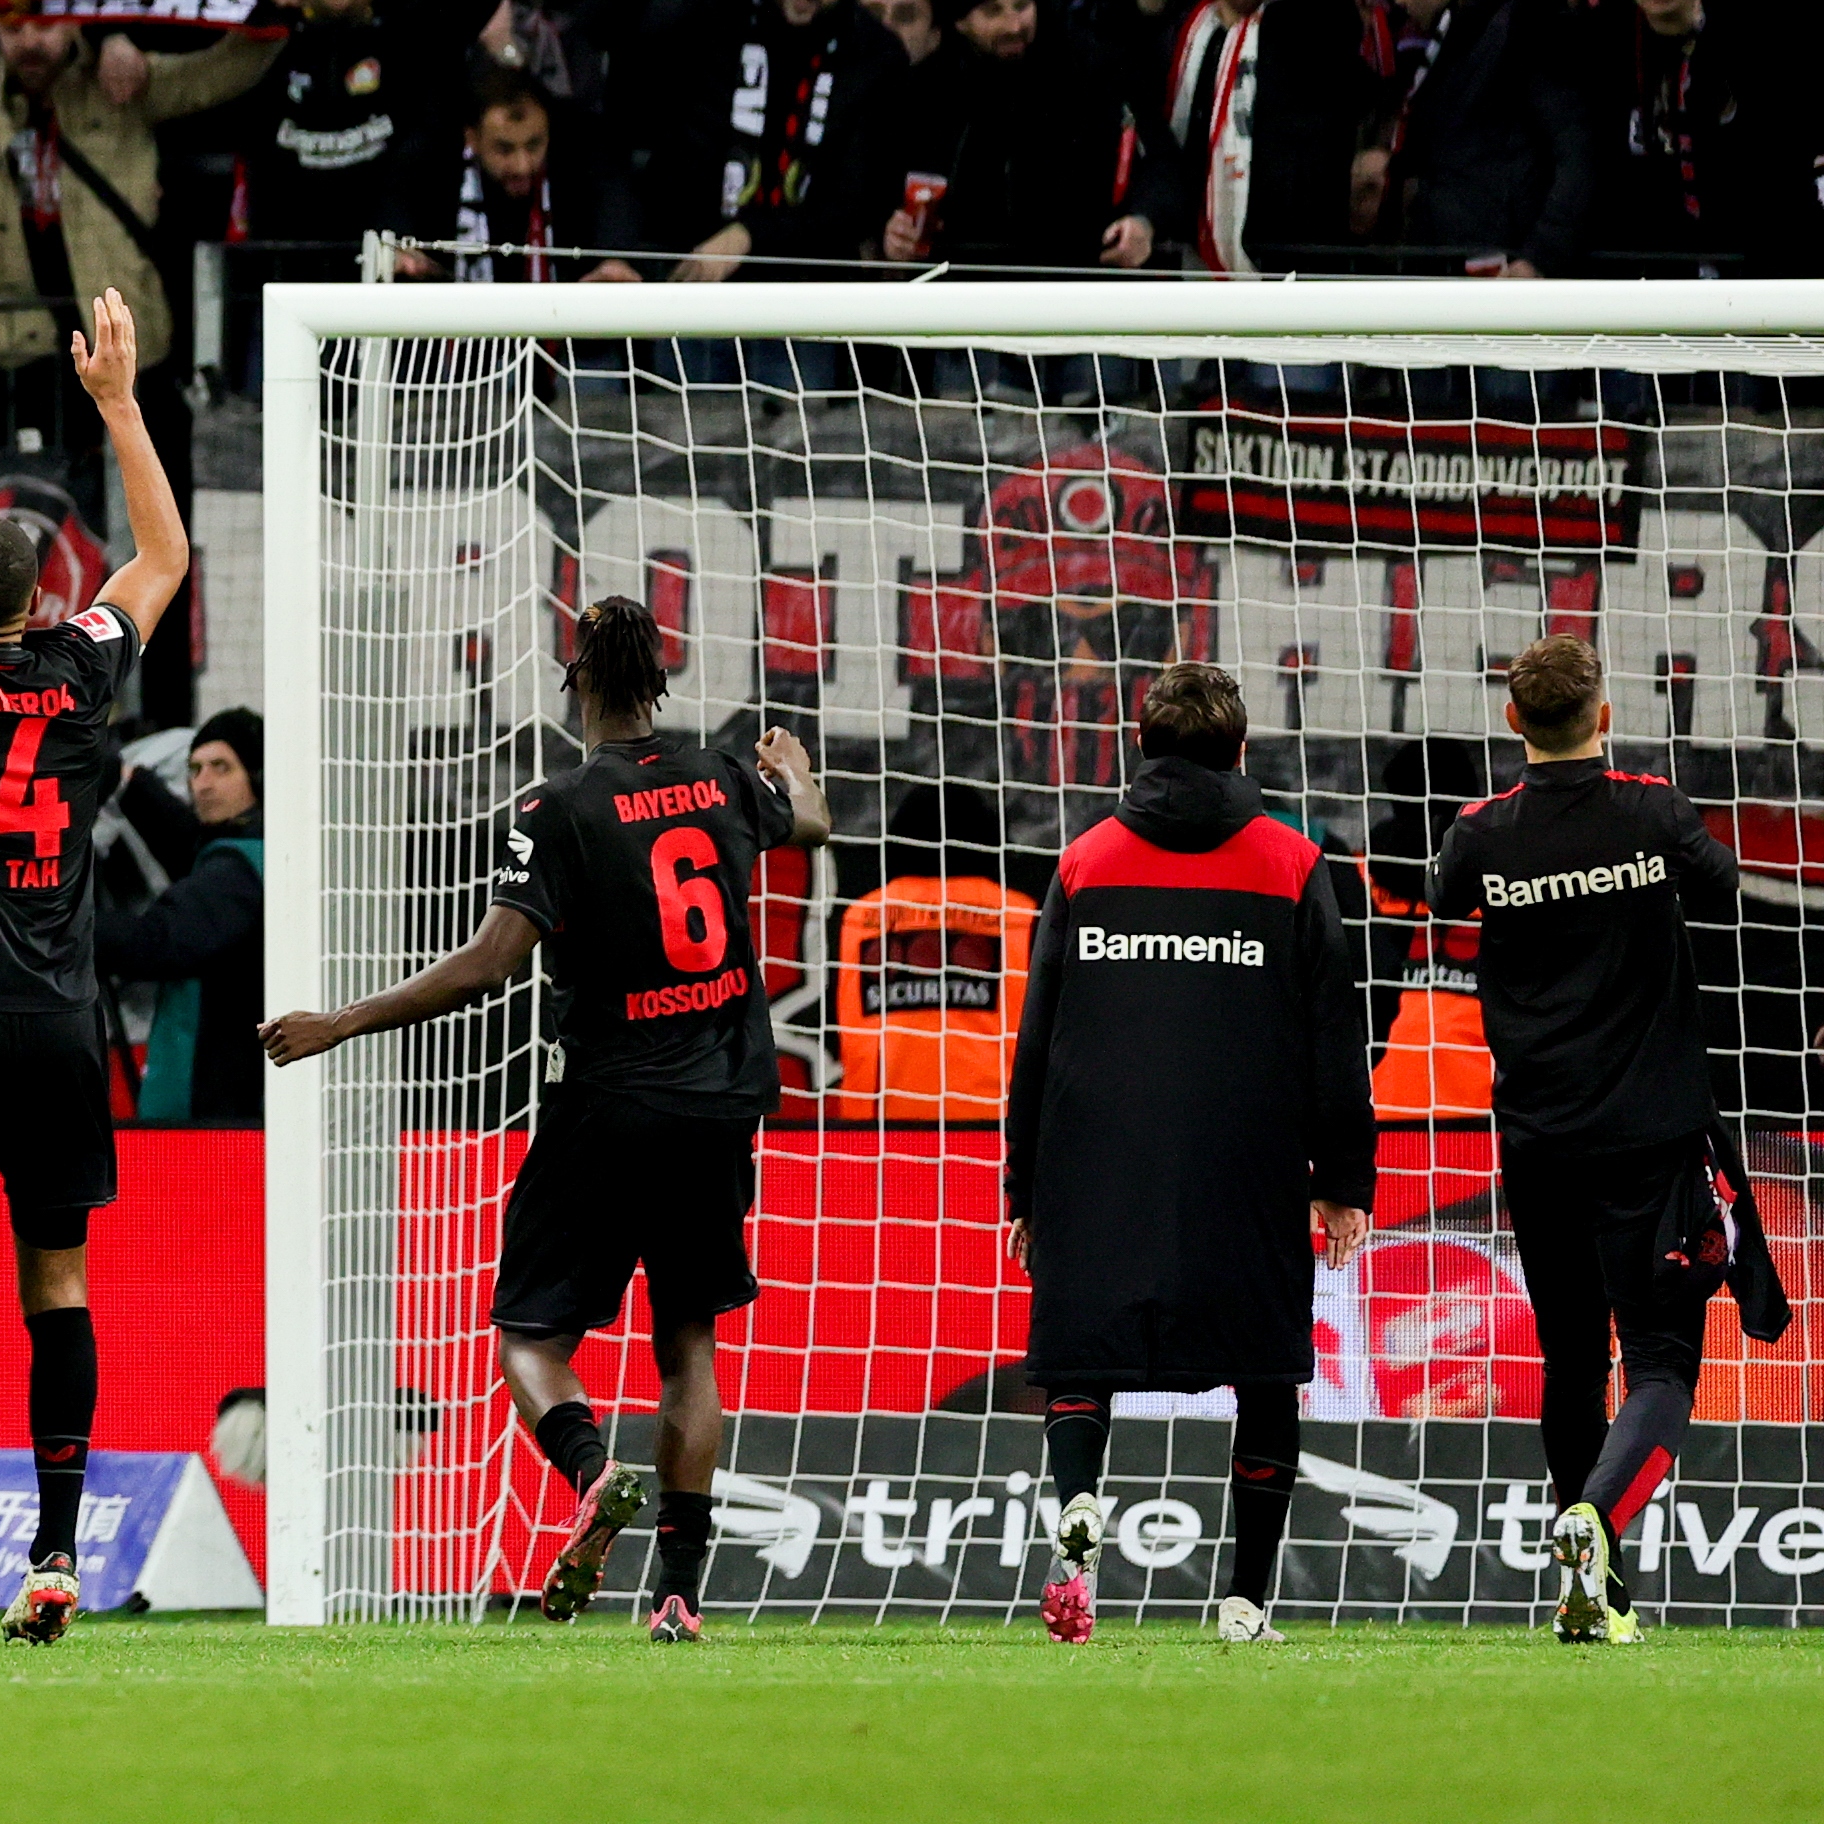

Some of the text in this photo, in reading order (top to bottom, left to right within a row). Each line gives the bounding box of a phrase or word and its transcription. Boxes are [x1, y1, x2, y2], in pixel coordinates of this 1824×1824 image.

[5, 858, 60, 889] TAH
[650, 827, 728, 973] 6
[1482, 851, 1666, 908] Barmenia
[1078, 926, 1264, 967] Barmenia
[626, 967, 749, 1021] KOSSOUU
[1488, 1481, 1824, 1578] tive
